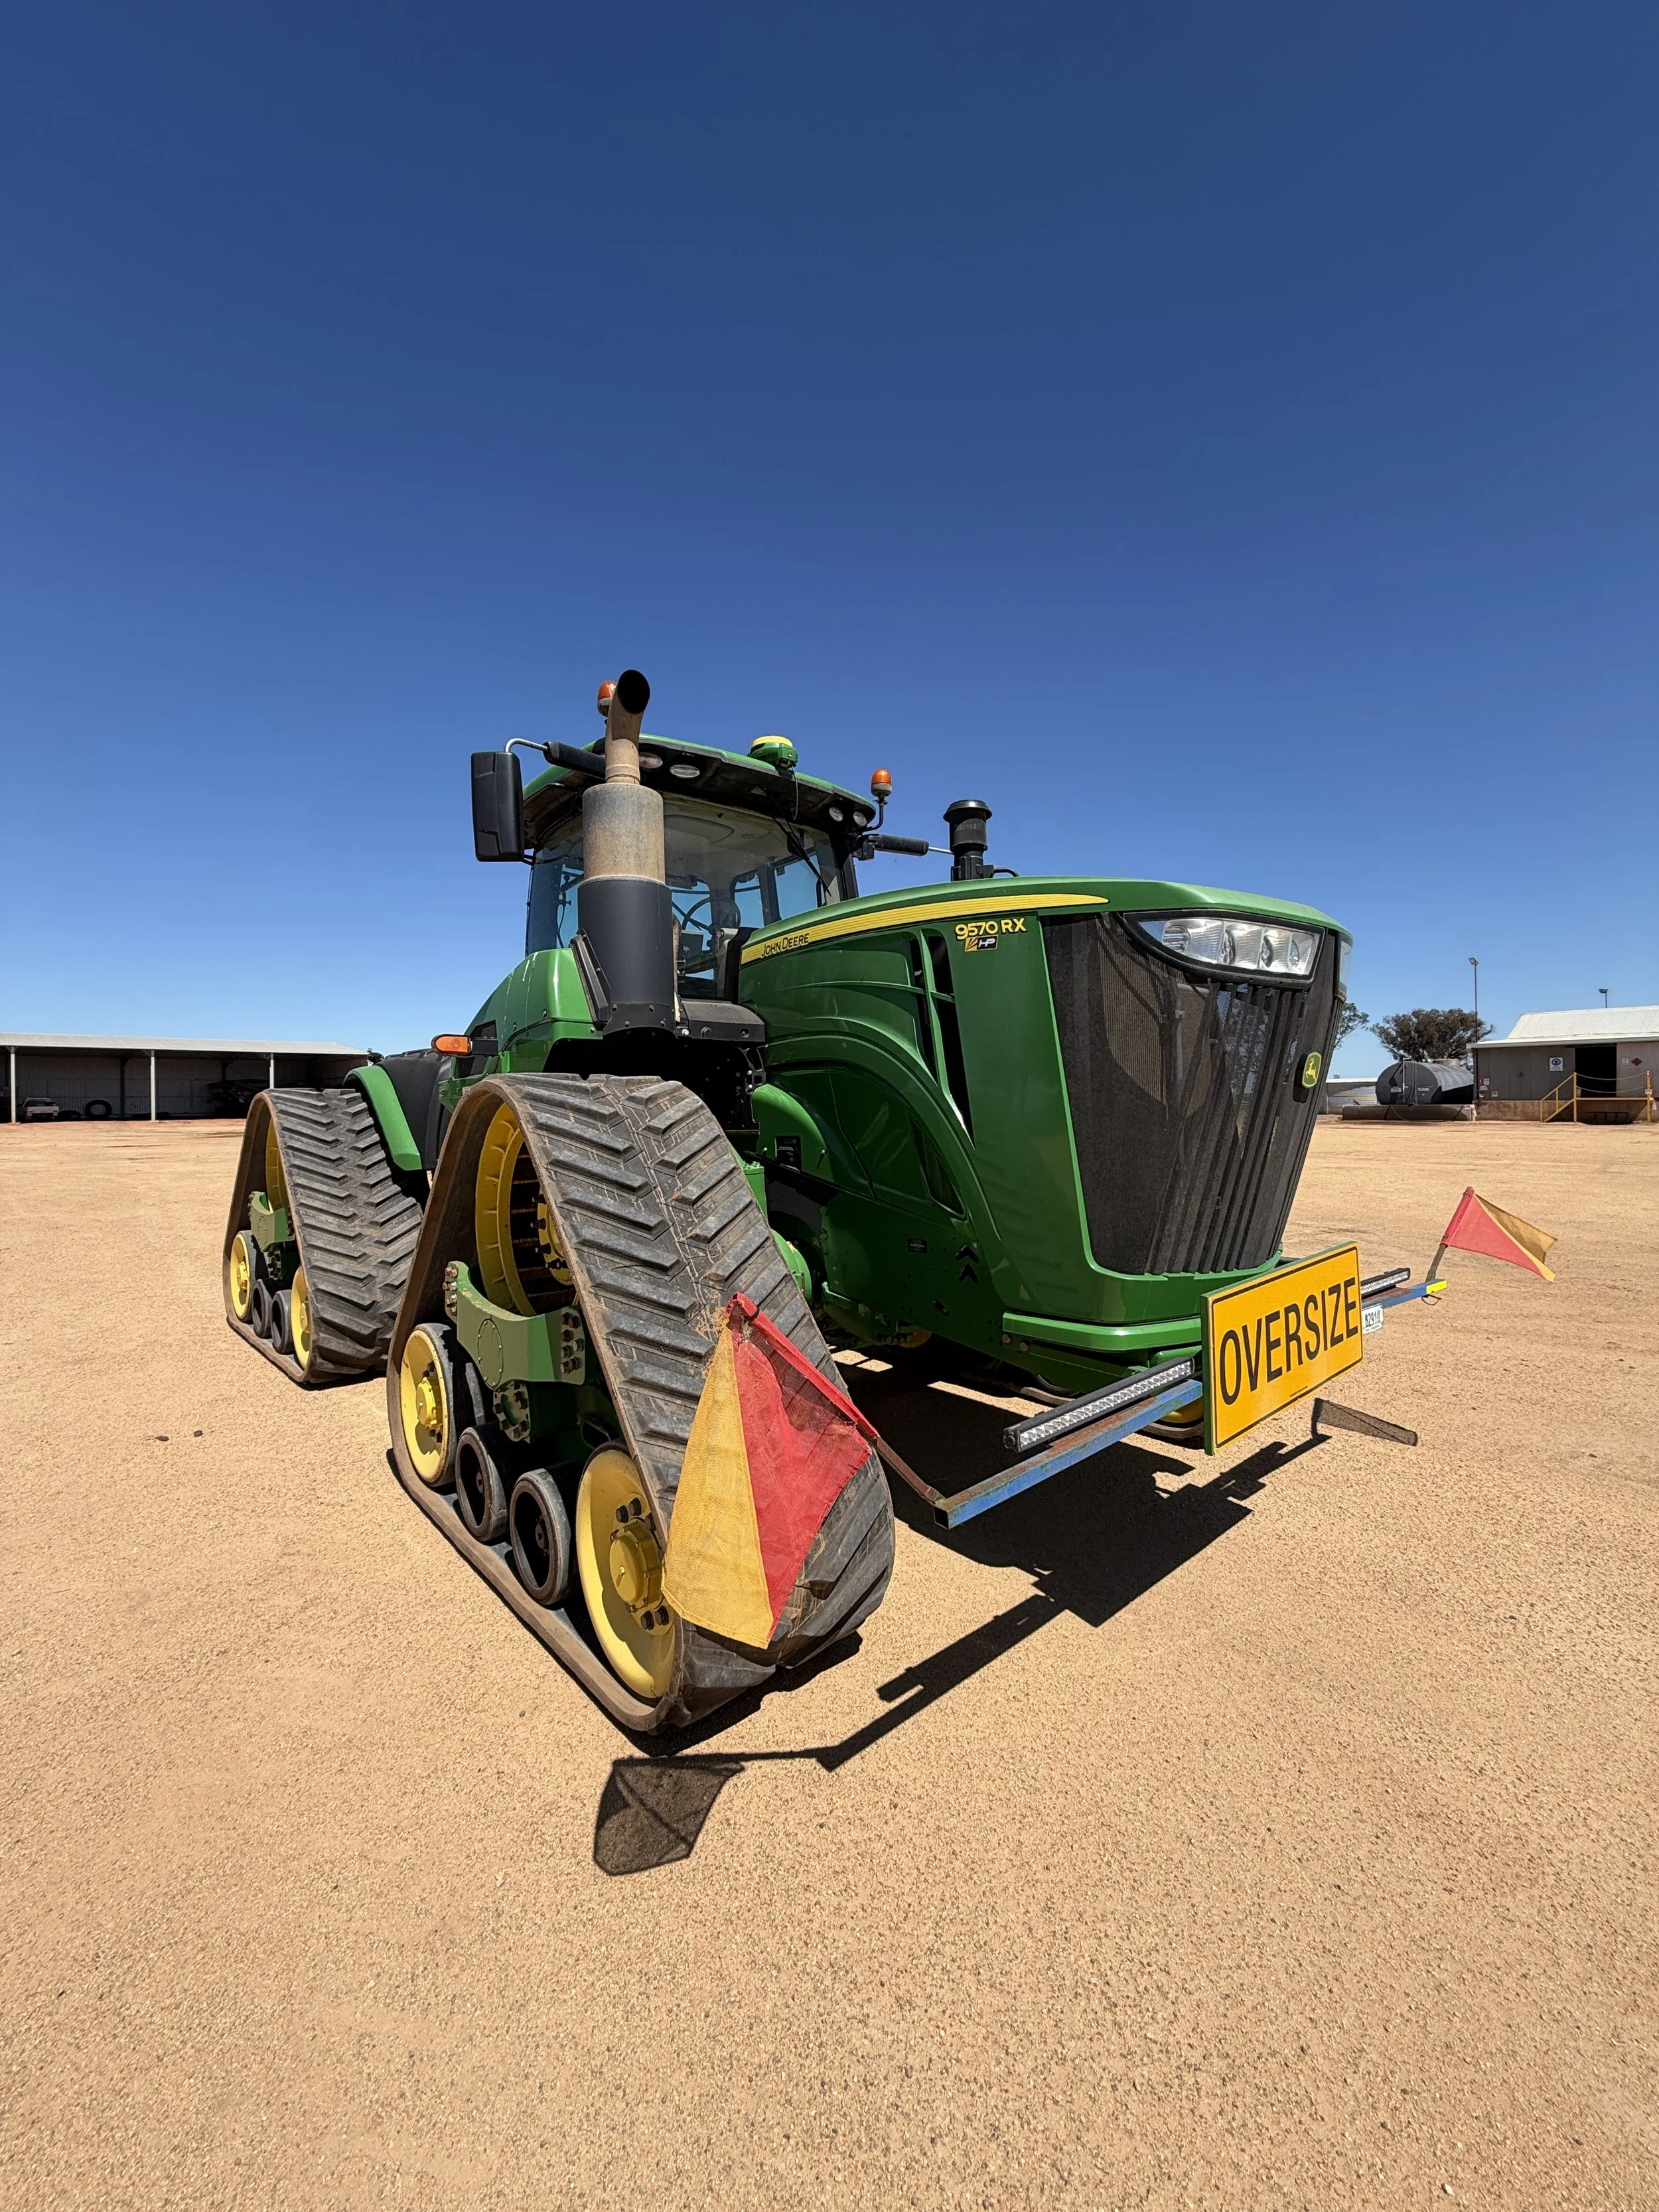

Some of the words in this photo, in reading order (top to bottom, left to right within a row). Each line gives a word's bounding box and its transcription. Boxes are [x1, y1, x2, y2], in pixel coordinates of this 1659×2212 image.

[955, 921, 999, 940] 9570
[1000, 917, 1027, 933] RX
[760, 940, 782, 957] JOHN
[782, 932, 810, 950] DEERE
[978, 938, 996, 948] HP
[1219, 1276, 1359, 1406] OVERSIZE
